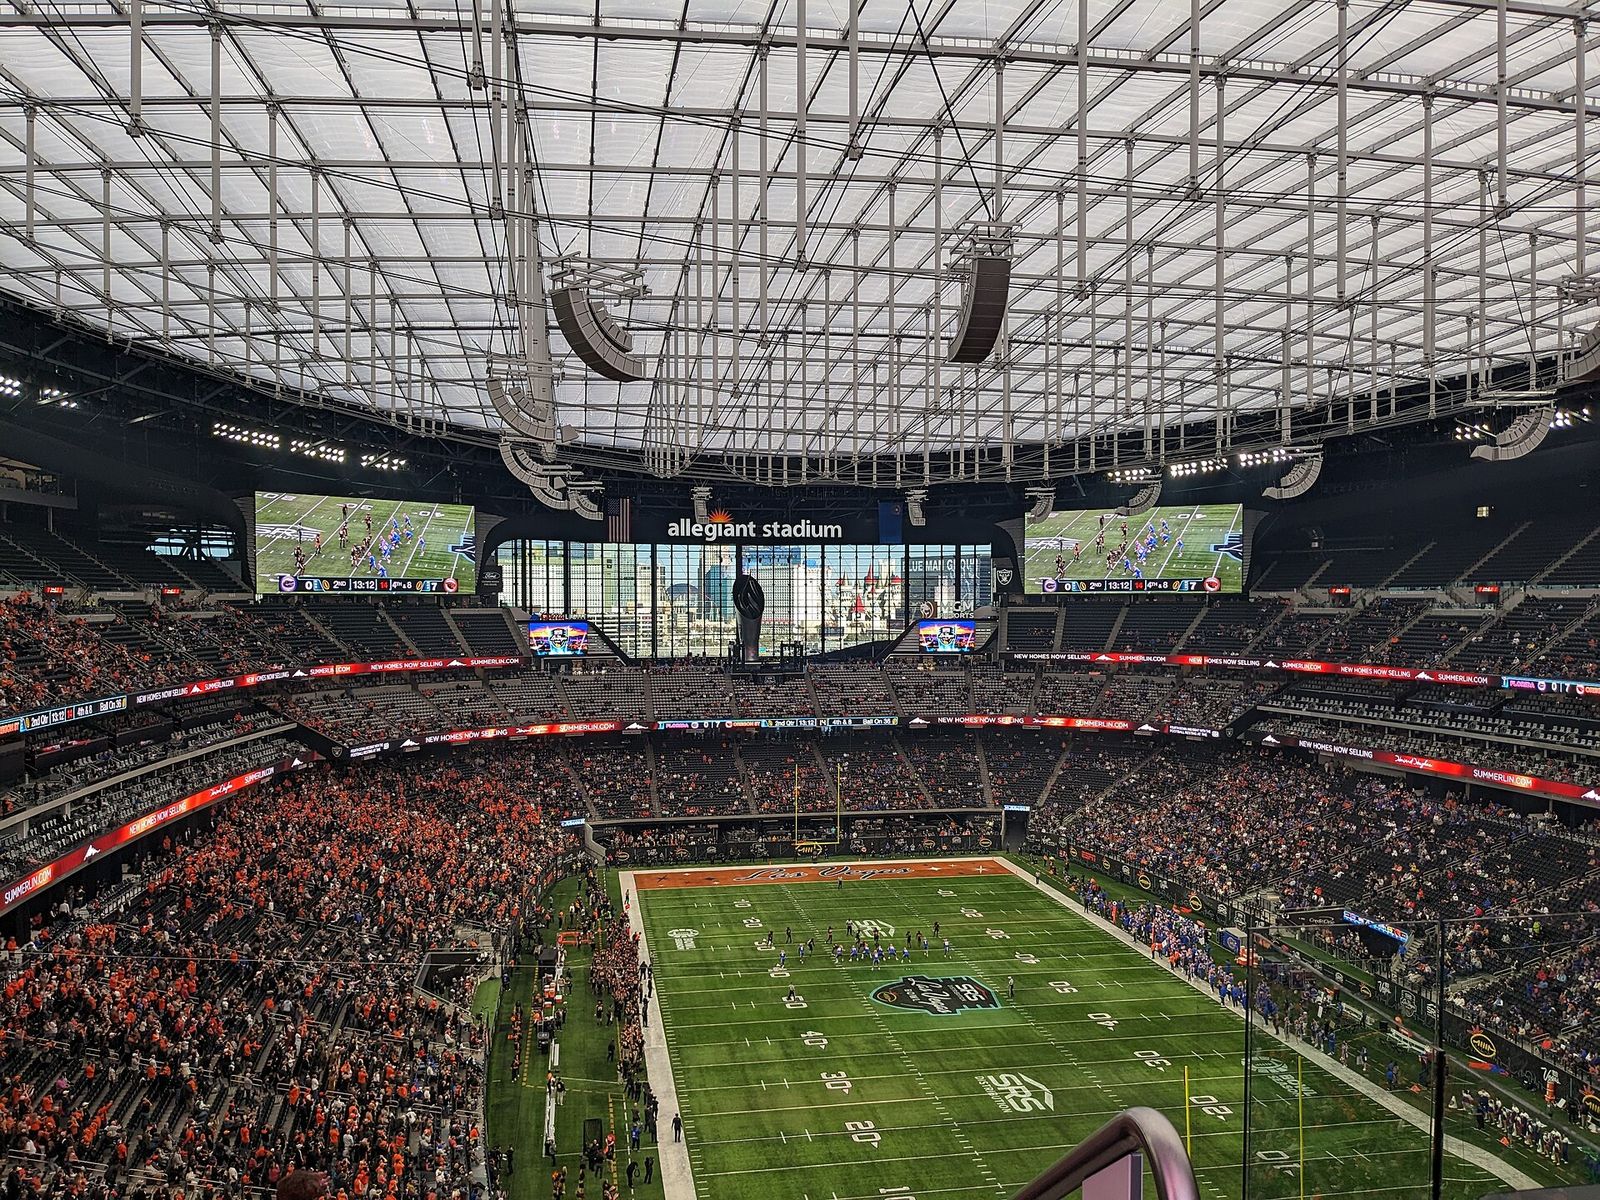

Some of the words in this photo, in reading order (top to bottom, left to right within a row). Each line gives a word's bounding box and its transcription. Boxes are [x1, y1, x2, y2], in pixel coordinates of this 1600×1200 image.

[667, 518, 756, 542] allegiant
[762, 520, 843, 538] stadium
[333, 580, 346, 589] 2ND
[353, 580, 375, 589] 13:12
[380, 580, 388, 589] 14
[406, 580, 412, 589] 8
[1090, 582, 1102, 590] 2ND
[1108, 582, 1129, 590] 13:12
[1190, 582, 1196, 590] 7
[1282, 662, 1322, 670] SUMMERLIN.COM
[204, 680, 234, 690] SUMMERLIN.COM
[255, 674, 267, 682] HOMES
[276, 672, 290, 680] SELLING
[1438, 674, 1488, 684] SUMMERLIN.COM
[1551, 682, 1558, 690] 0
[1564, 684, 1570, 692] 7
[136, 694, 147, 704] NEW
[147, 692, 161, 702] HOMES
[161, 691, 172, 700] NOW
[172, 688, 188, 698] SELLING
[31, 717, 40, 727] 2nd
[52, 711, 65, 722] 13:12
[560, 722, 614, 732] SUMMERLIN.COM
[1075, 720, 1128, 729] SUMMERLIN.COM
[426, 736, 440, 744] NEW
[440, 733, 464, 742] HOMES
[464, 731, 480, 739] NOW
[480, 728, 508, 738] SELLING
[1300, 740, 1312, 748] NEW
[1313, 742, 1332, 752] HOMES
[1334, 745, 1348, 754] NOW
[1349, 748, 1373, 759] SELLING
[244, 768, 274, 784] SUMMERLIN.COM
[1473, 769, 1532, 788] SUMMERLIN.COM
[129, 822, 140, 836] NEW
[140, 816, 157, 831] HOMES
[156, 810, 168, 824] NOW
[168, 802, 187, 818] SELLING
[733, 868, 809, 882] Las
[818, 866, 914, 880] Vegas
[4, 868, 52, 904] SUMMERLIN.COM
[954, 983, 986, 1002] SRS
[1048, 980, 1079, 994] 50
[1088, 1012, 1120, 1027] 40
[800, 1031, 828, 1046] 40
[1133, 1050, 1172, 1069] 30
[820, 1071, 852, 1090] 30
[974, 1076, 1013, 1114] DISTRIBUTION
[986, 1074, 1047, 1112] SRS
[1189, 1094, 1234, 1116] 20
[844, 1120, 882, 1143] 20
